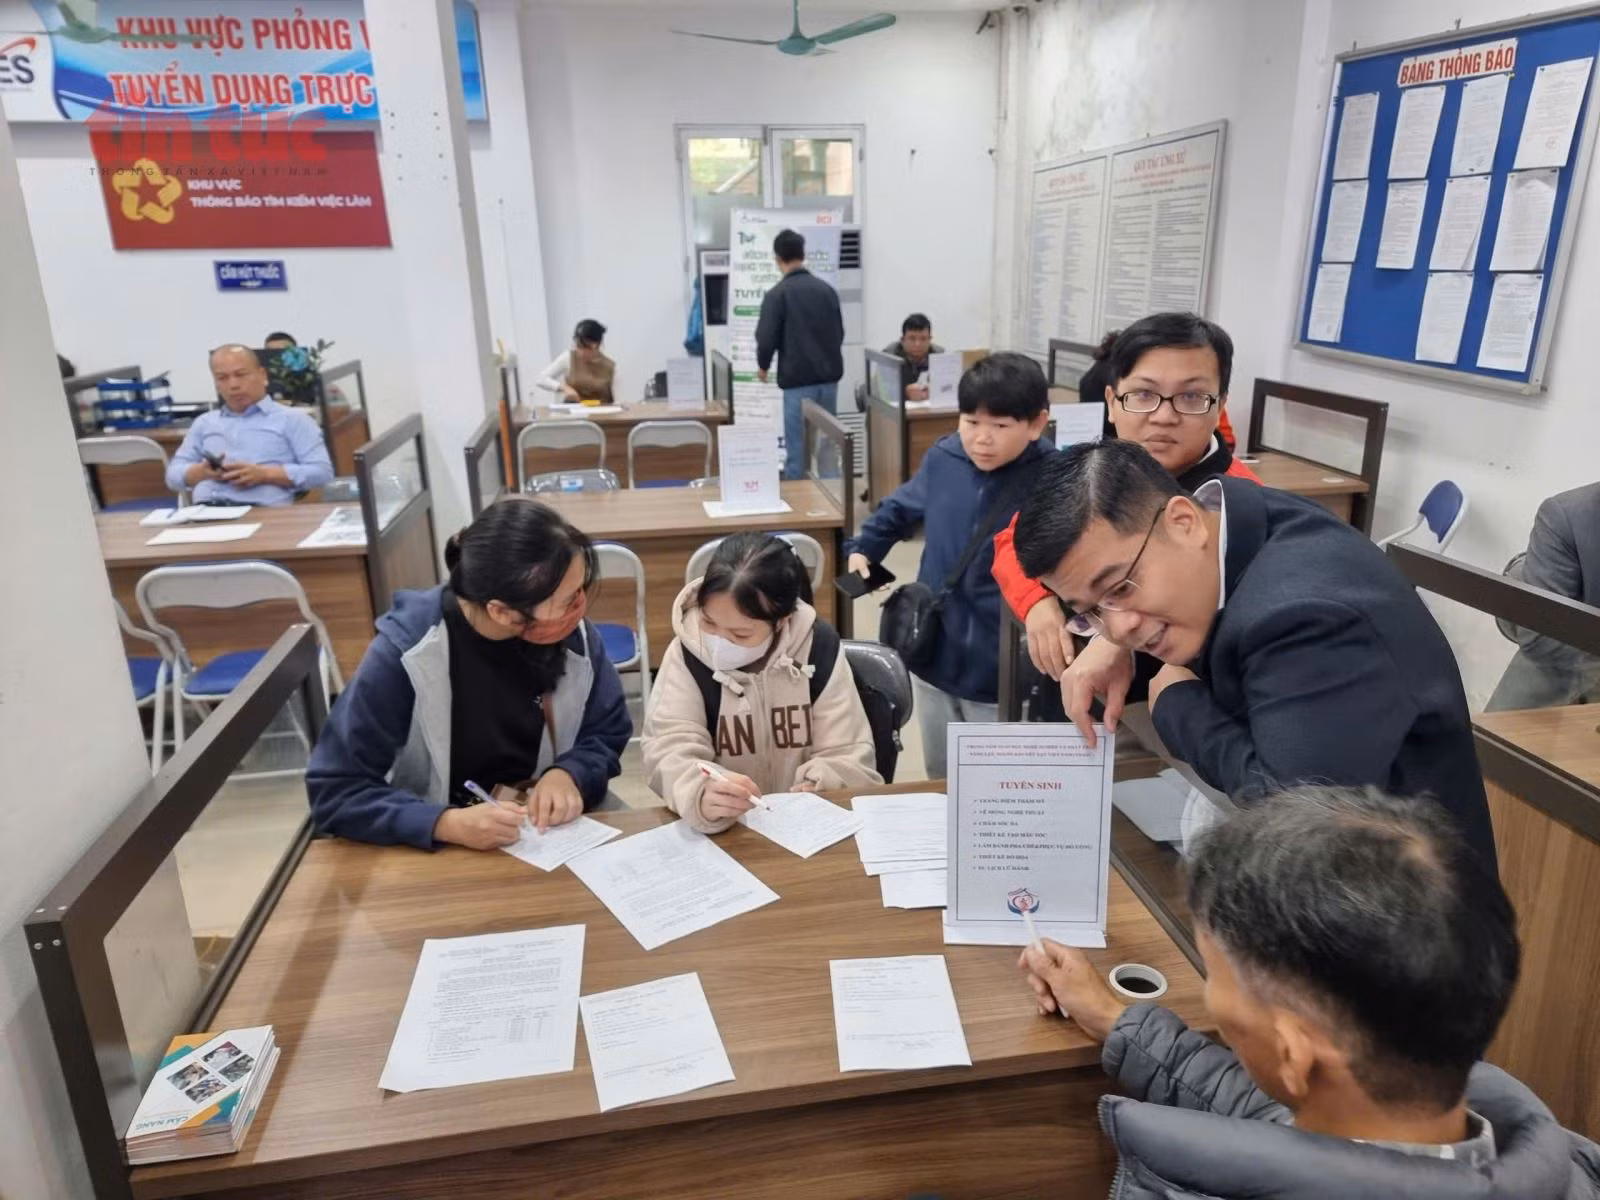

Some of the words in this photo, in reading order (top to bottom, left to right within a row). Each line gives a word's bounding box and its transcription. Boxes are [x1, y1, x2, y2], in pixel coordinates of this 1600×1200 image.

[115, 16, 177, 49] KHU
[184, 13, 244, 57] VỰC
[252, 7, 352, 50] PHỎNG
[1400, 56, 1434, 84] BẢNG
[1485, 44, 1514, 72] BÁO
[109, 60, 206, 104] TUYỂN
[212, 74, 292, 111] DỤNG
[299, 72, 373, 111] TRỰC
[187, 179, 215, 190] KHU
[215, 179, 242, 191] VỰC
[190, 195, 233, 207] THÔNG
[235, 195, 262, 207] BÁO
